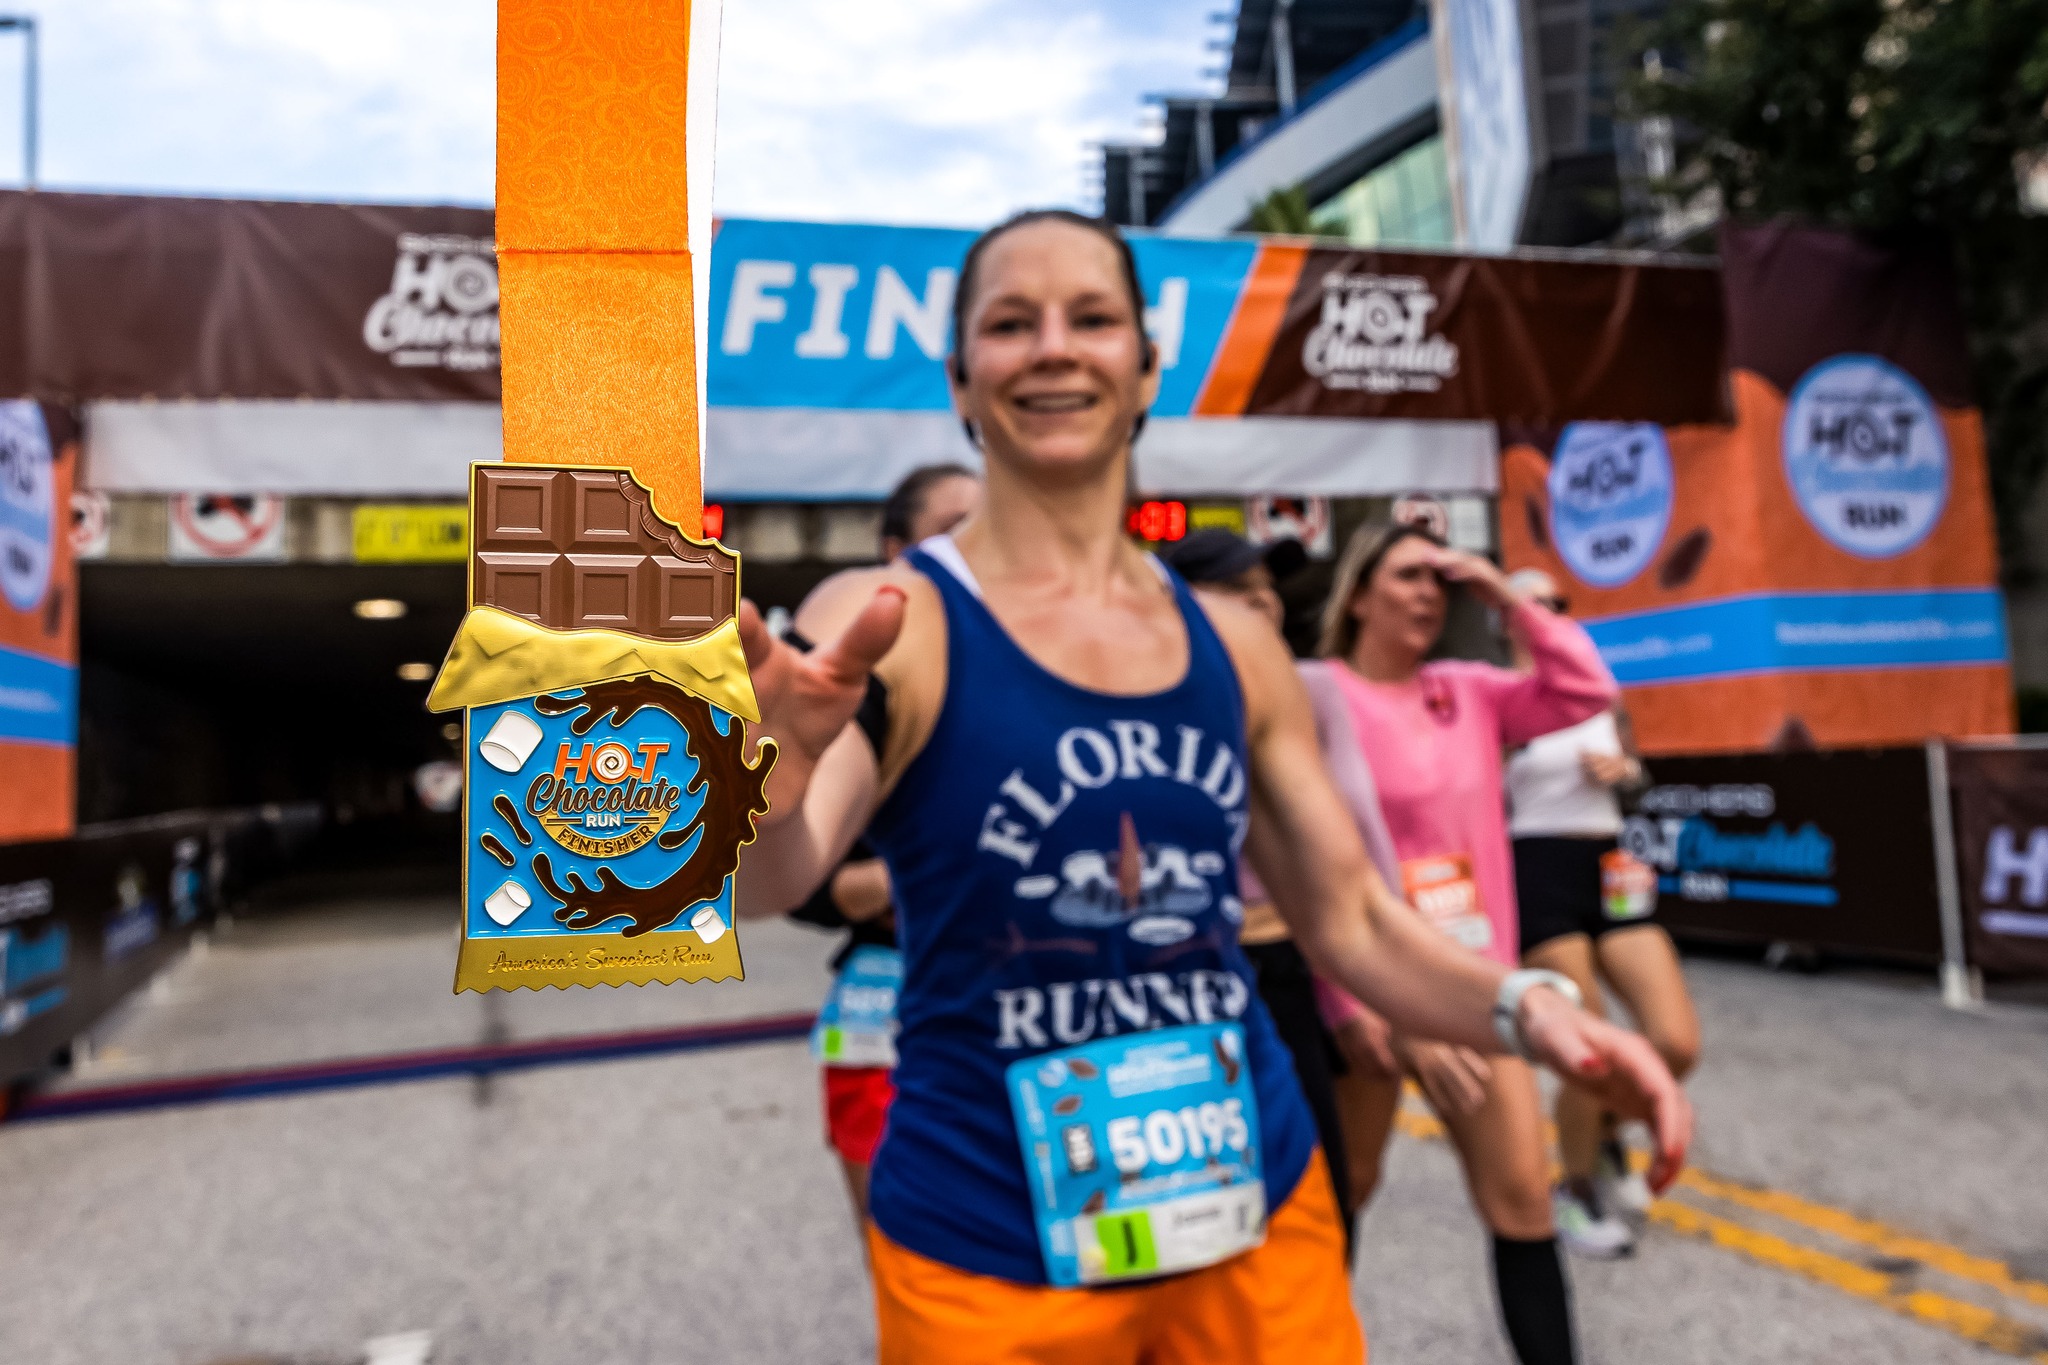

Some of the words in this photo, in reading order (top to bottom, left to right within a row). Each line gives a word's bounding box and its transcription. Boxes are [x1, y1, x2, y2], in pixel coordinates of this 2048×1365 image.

[392, 250, 498, 312] HO
[721, 258, 1189, 370] FINH
[1320, 292, 1437, 345] HOT
[553, 742, 671, 784] HOT
[526, 773, 681, 817] Chocolate
[557, 824, 656, 855] FINISHER
[586, 813, 622, 828] RUN
[488, 950, 579, 974] America's
[585, 945, 667, 970] Sweetest
[672, 945, 714, 967] Run
[1107, 1098, 1248, 1172] 50195
